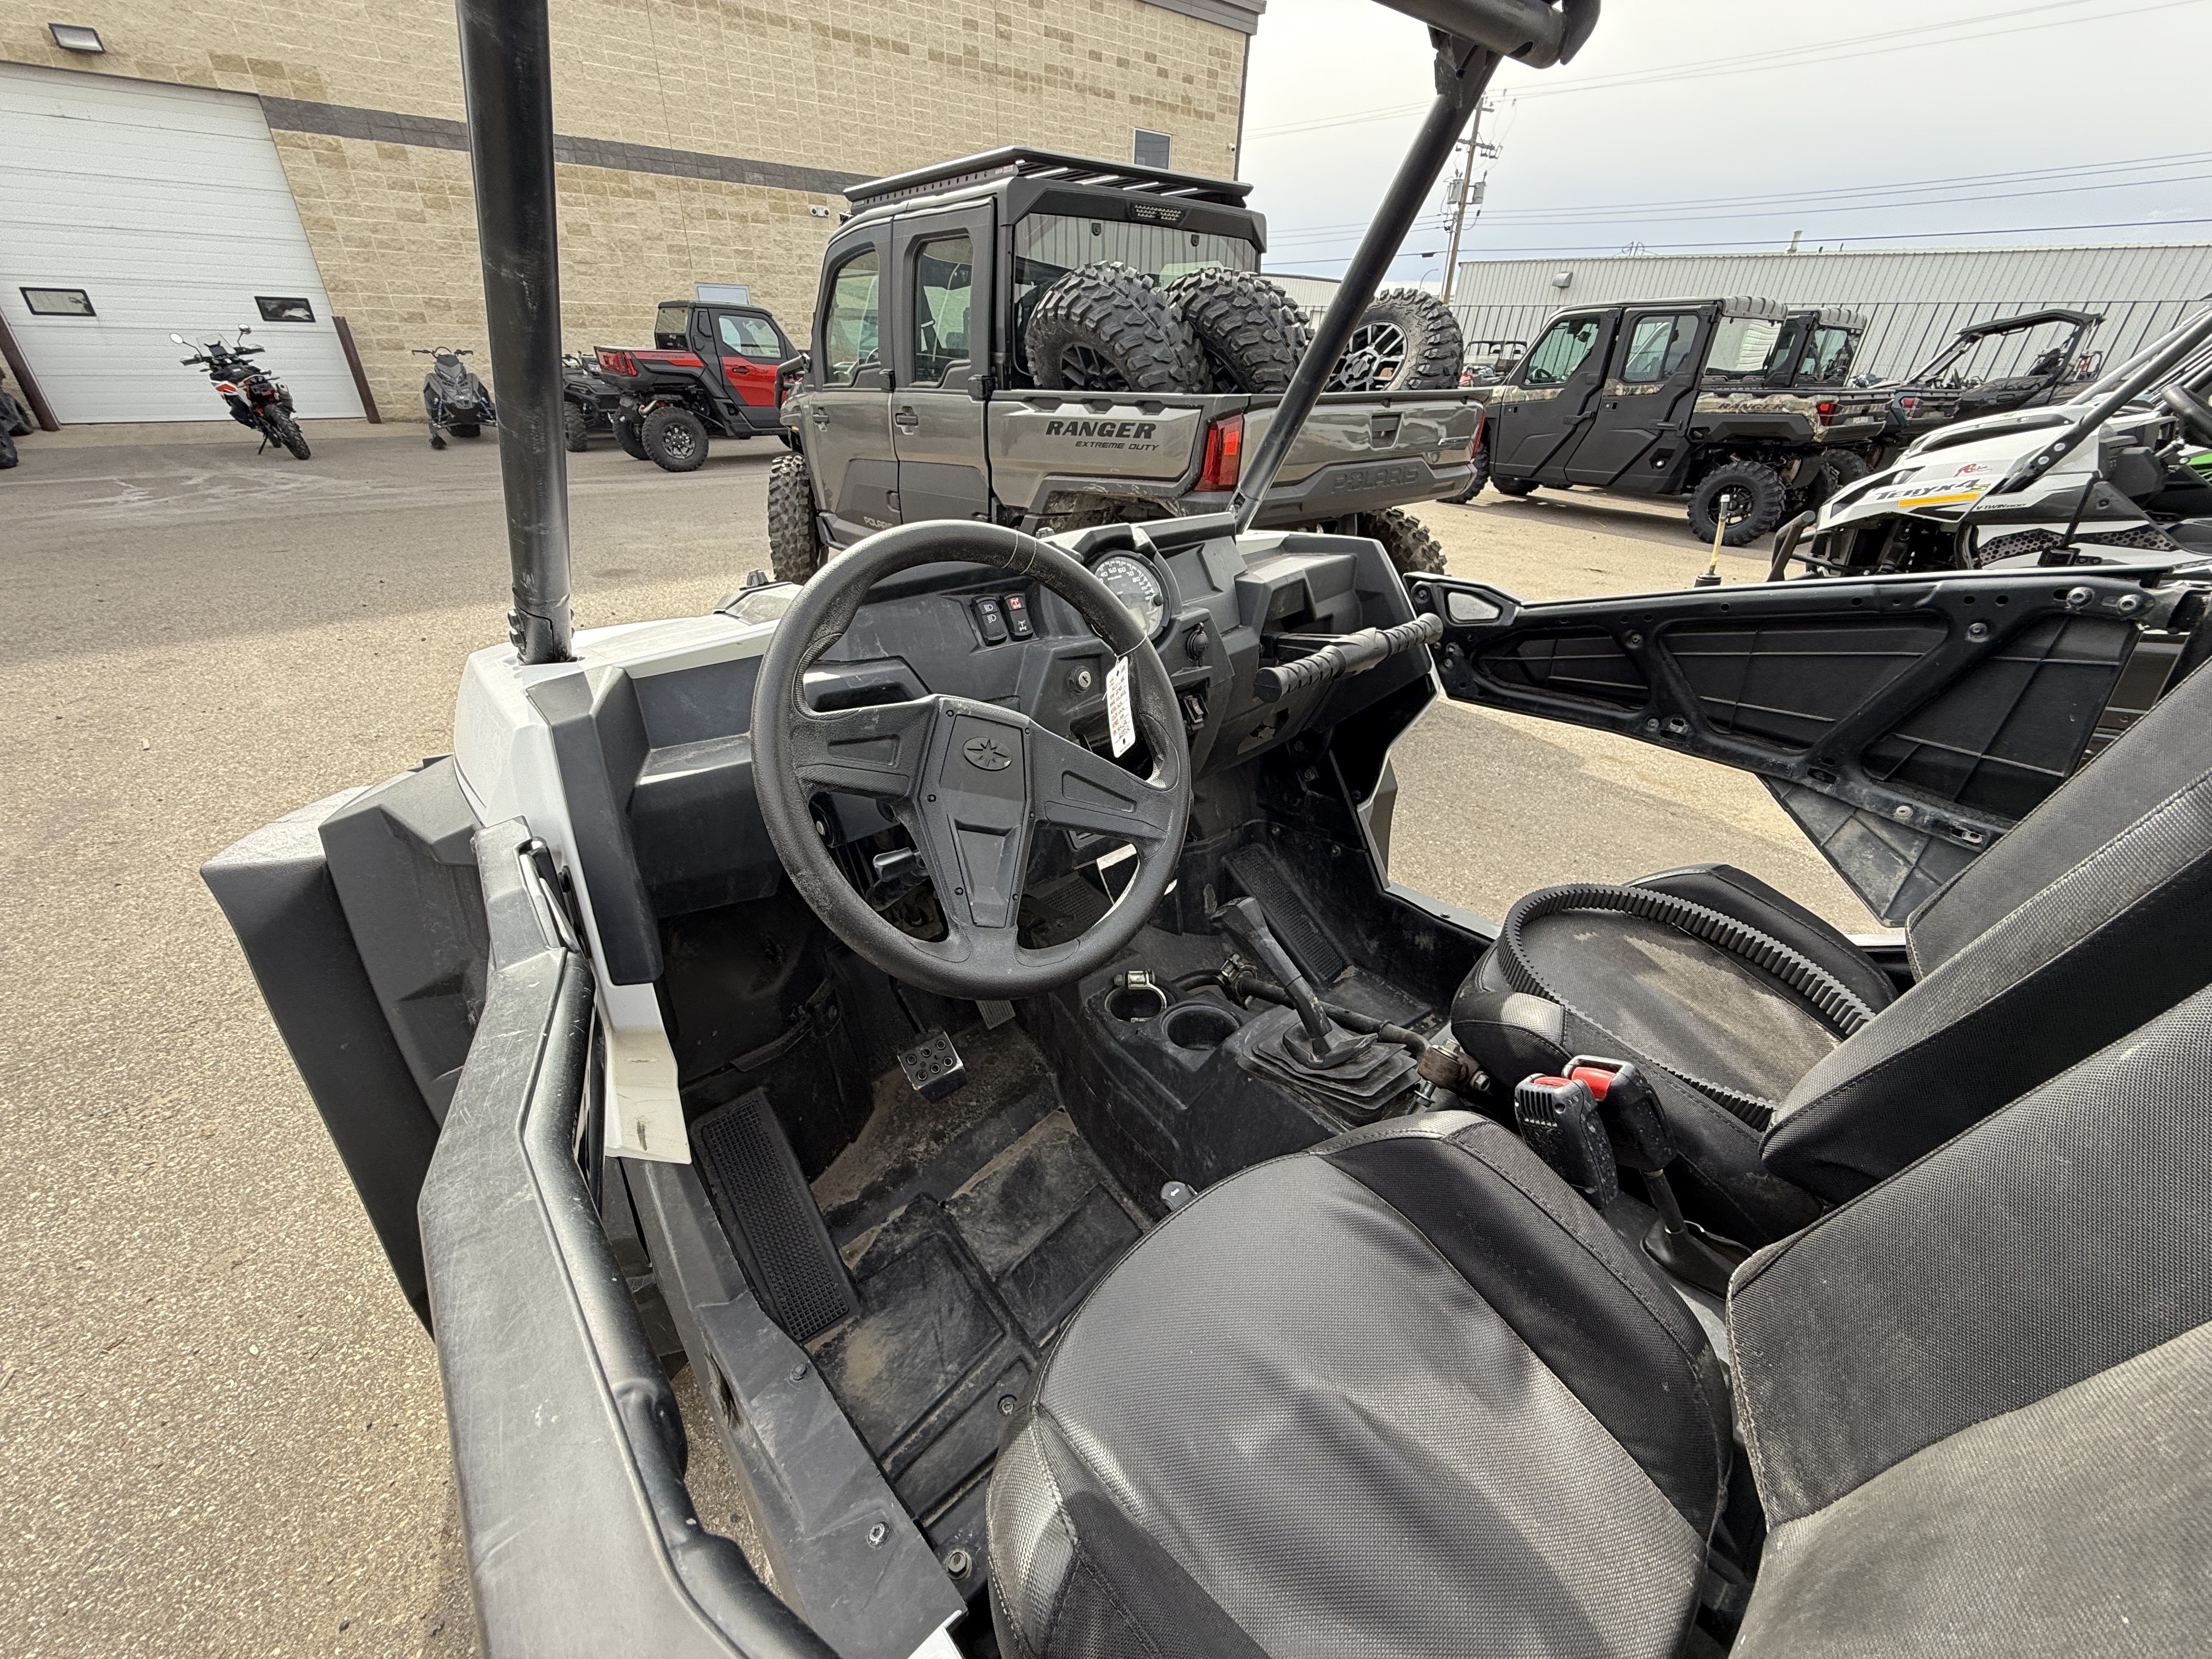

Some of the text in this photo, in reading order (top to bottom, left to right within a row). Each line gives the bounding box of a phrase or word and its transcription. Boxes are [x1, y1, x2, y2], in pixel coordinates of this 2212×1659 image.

[1045, 421, 1156, 439] RANGER
[1075, 441, 1126, 449] EXTREME
[1330, 466, 1419, 494] POLARIS
